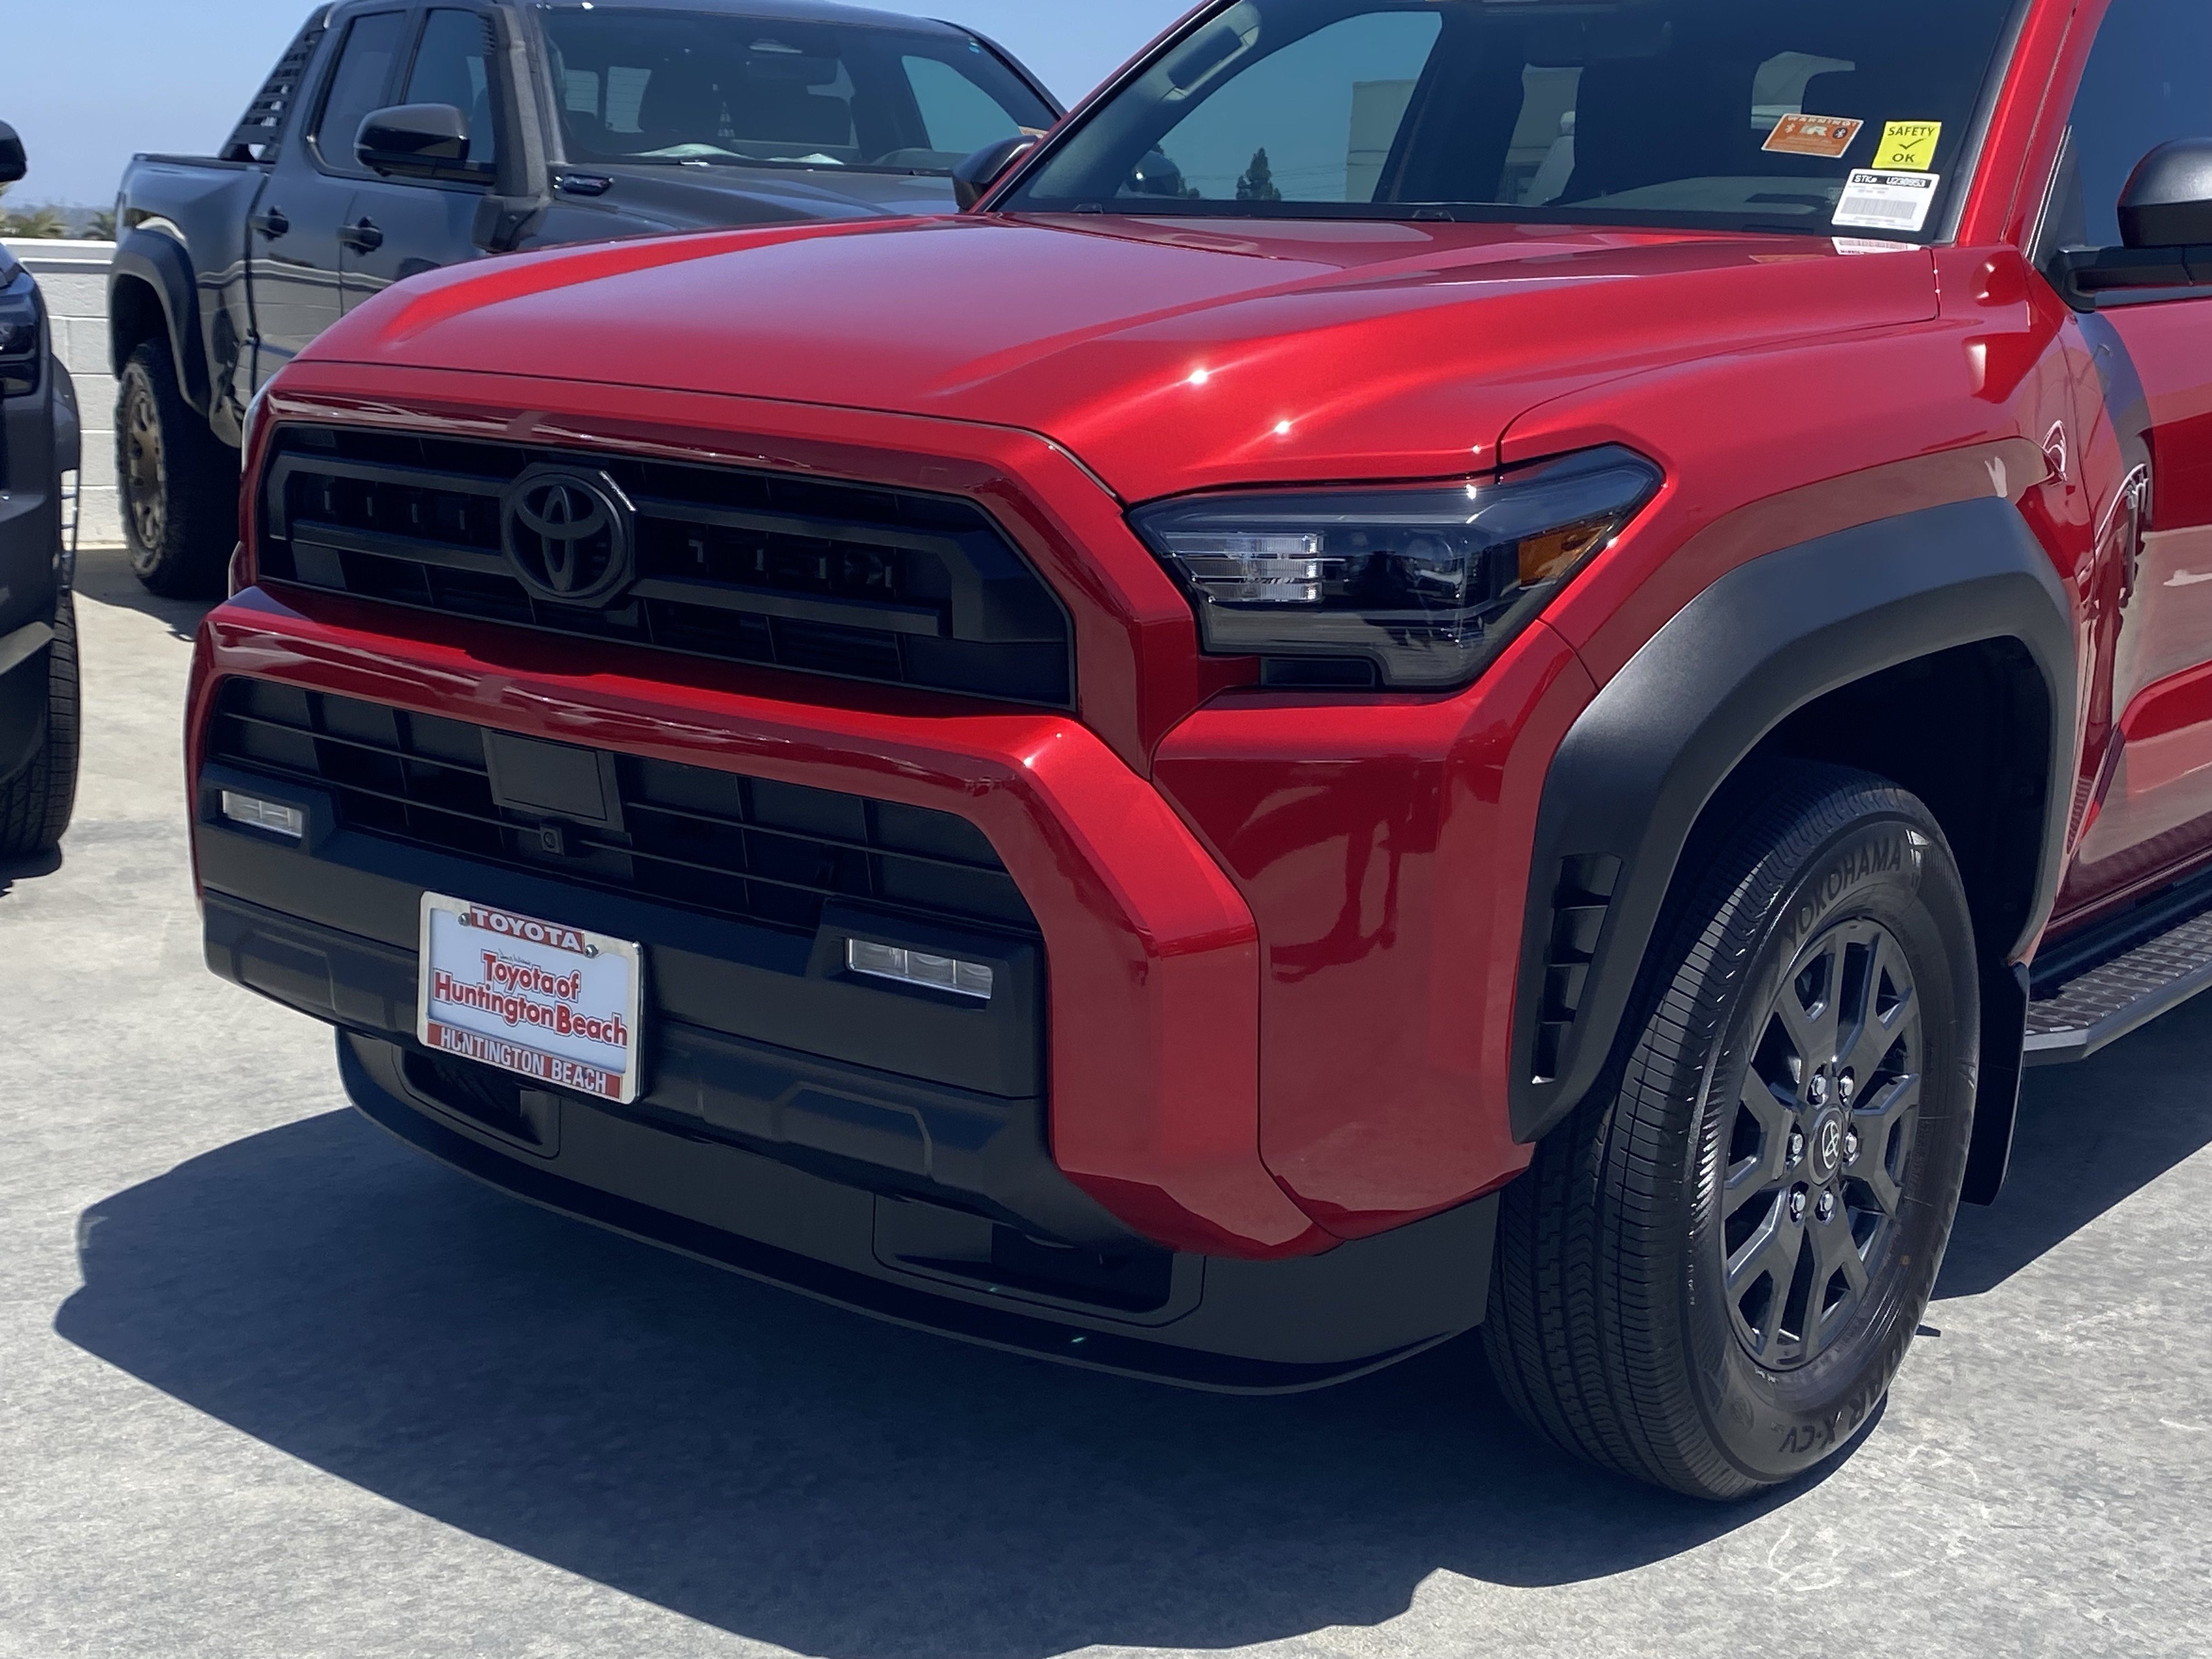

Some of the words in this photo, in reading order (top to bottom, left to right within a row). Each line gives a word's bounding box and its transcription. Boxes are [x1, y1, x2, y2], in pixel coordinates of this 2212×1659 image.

[1887, 126, 1936, 137] SAFETY
[1892, 153, 1916, 162] OK
[1785, 838, 1901, 949] YOKOHAMA
[471, 908, 581, 952] TOYOTA
[482, 951, 555, 994] Toyota
[555, 970, 580, 1001] of
[433, 970, 554, 1026] Huntington
[555, 1005, 627, 1046] Beach
[440, 1026, 544, 1077] HUNTINGTON
[551, 1059, 607, 1095] BEACH
